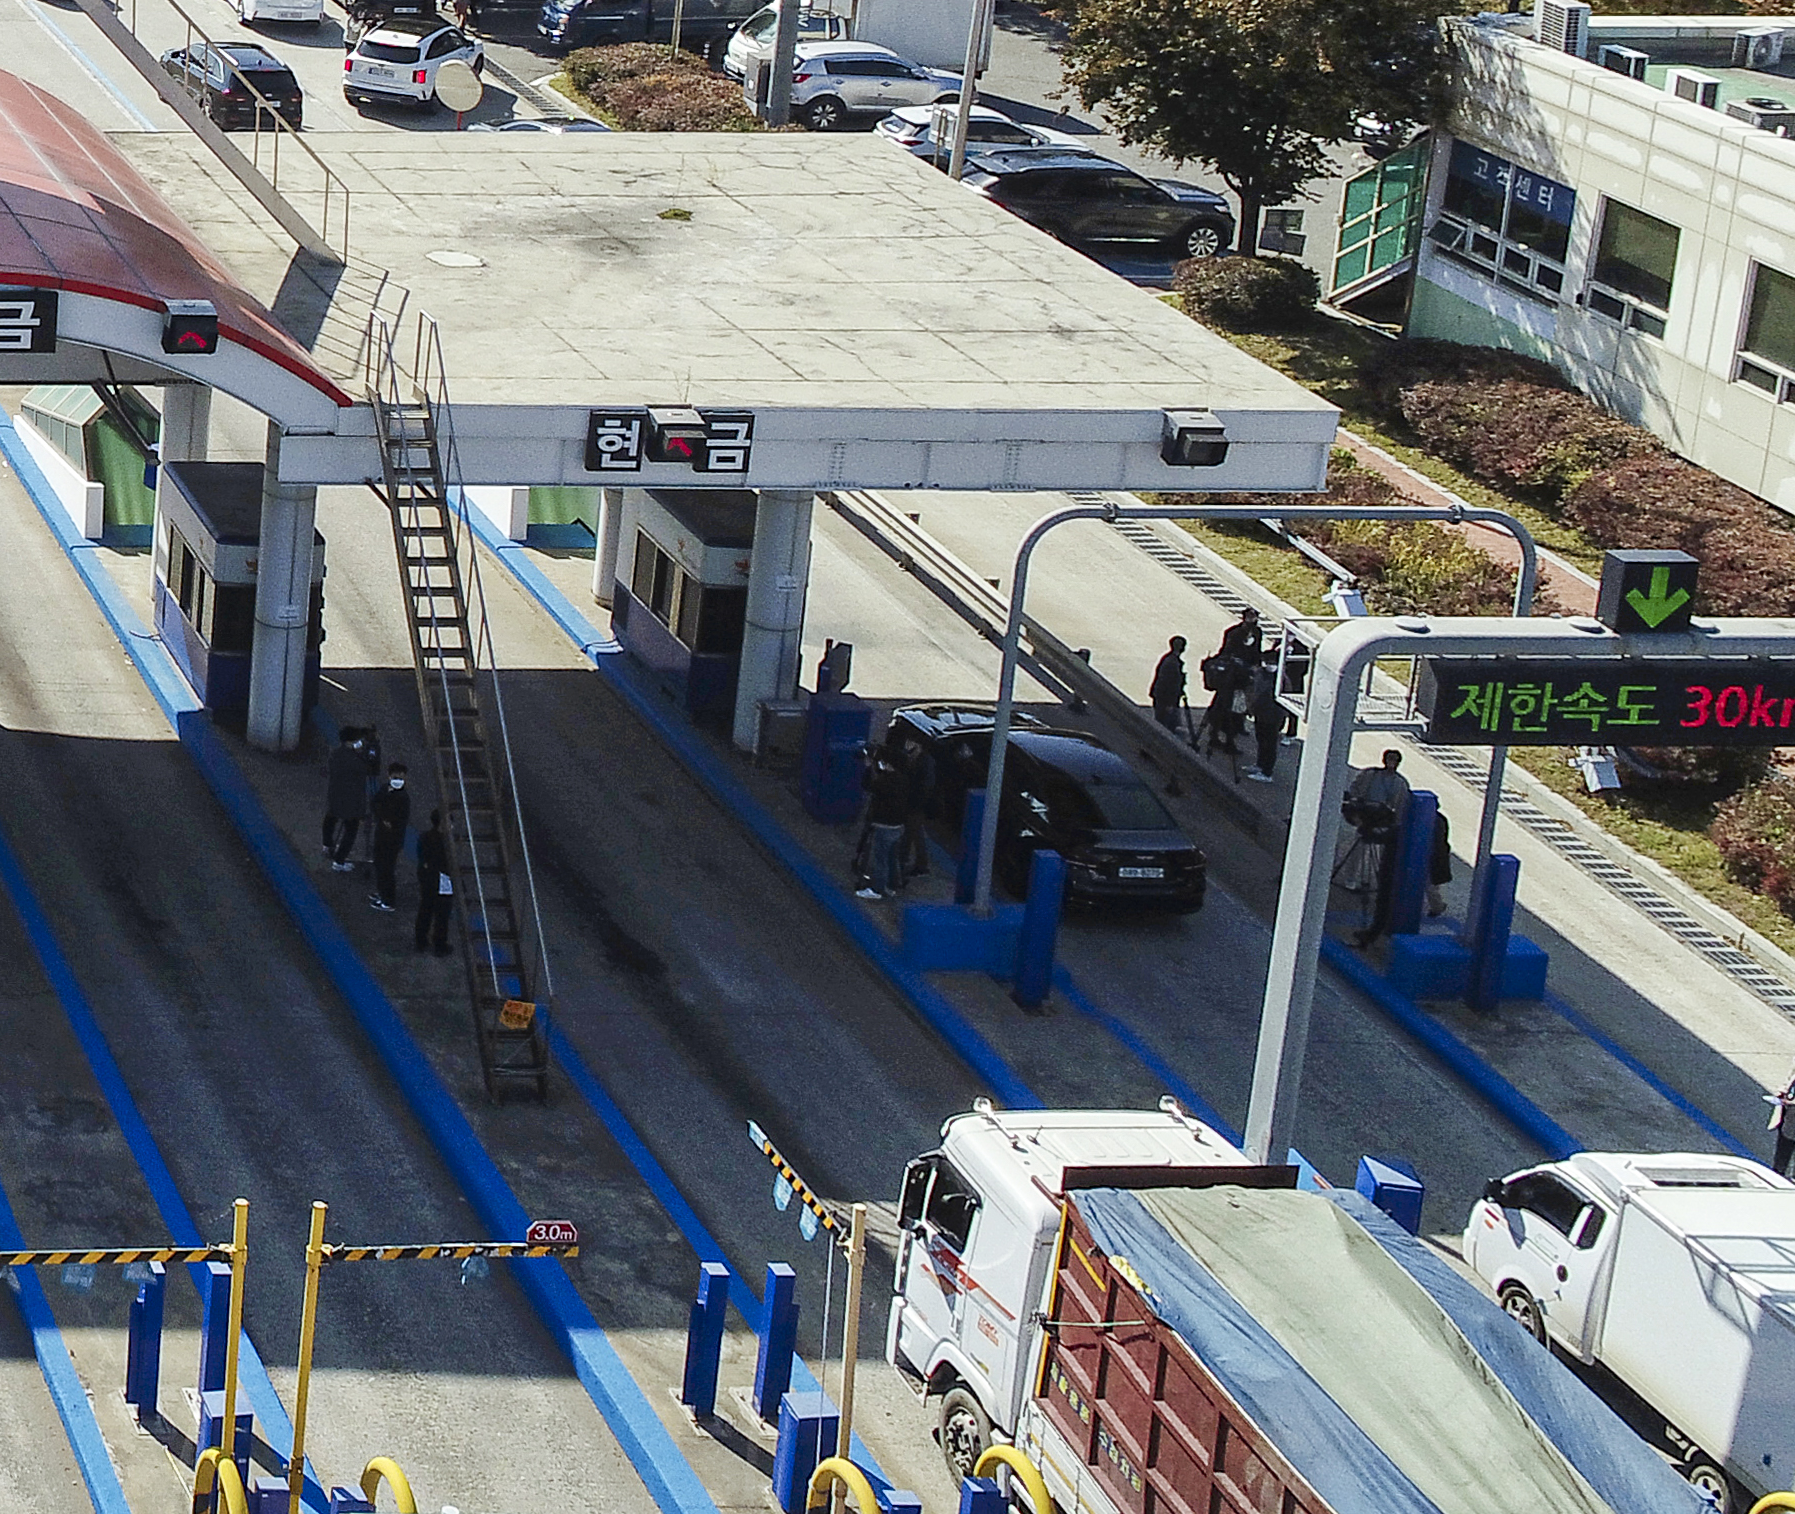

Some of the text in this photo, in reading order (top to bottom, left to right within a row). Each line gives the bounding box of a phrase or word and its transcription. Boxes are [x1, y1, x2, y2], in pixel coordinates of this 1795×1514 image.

[596, 418, 752, 470] 현금
[1450, 681, 1660, 732] 제한속도
[534, 1224, 573, 1241] 3.0m
